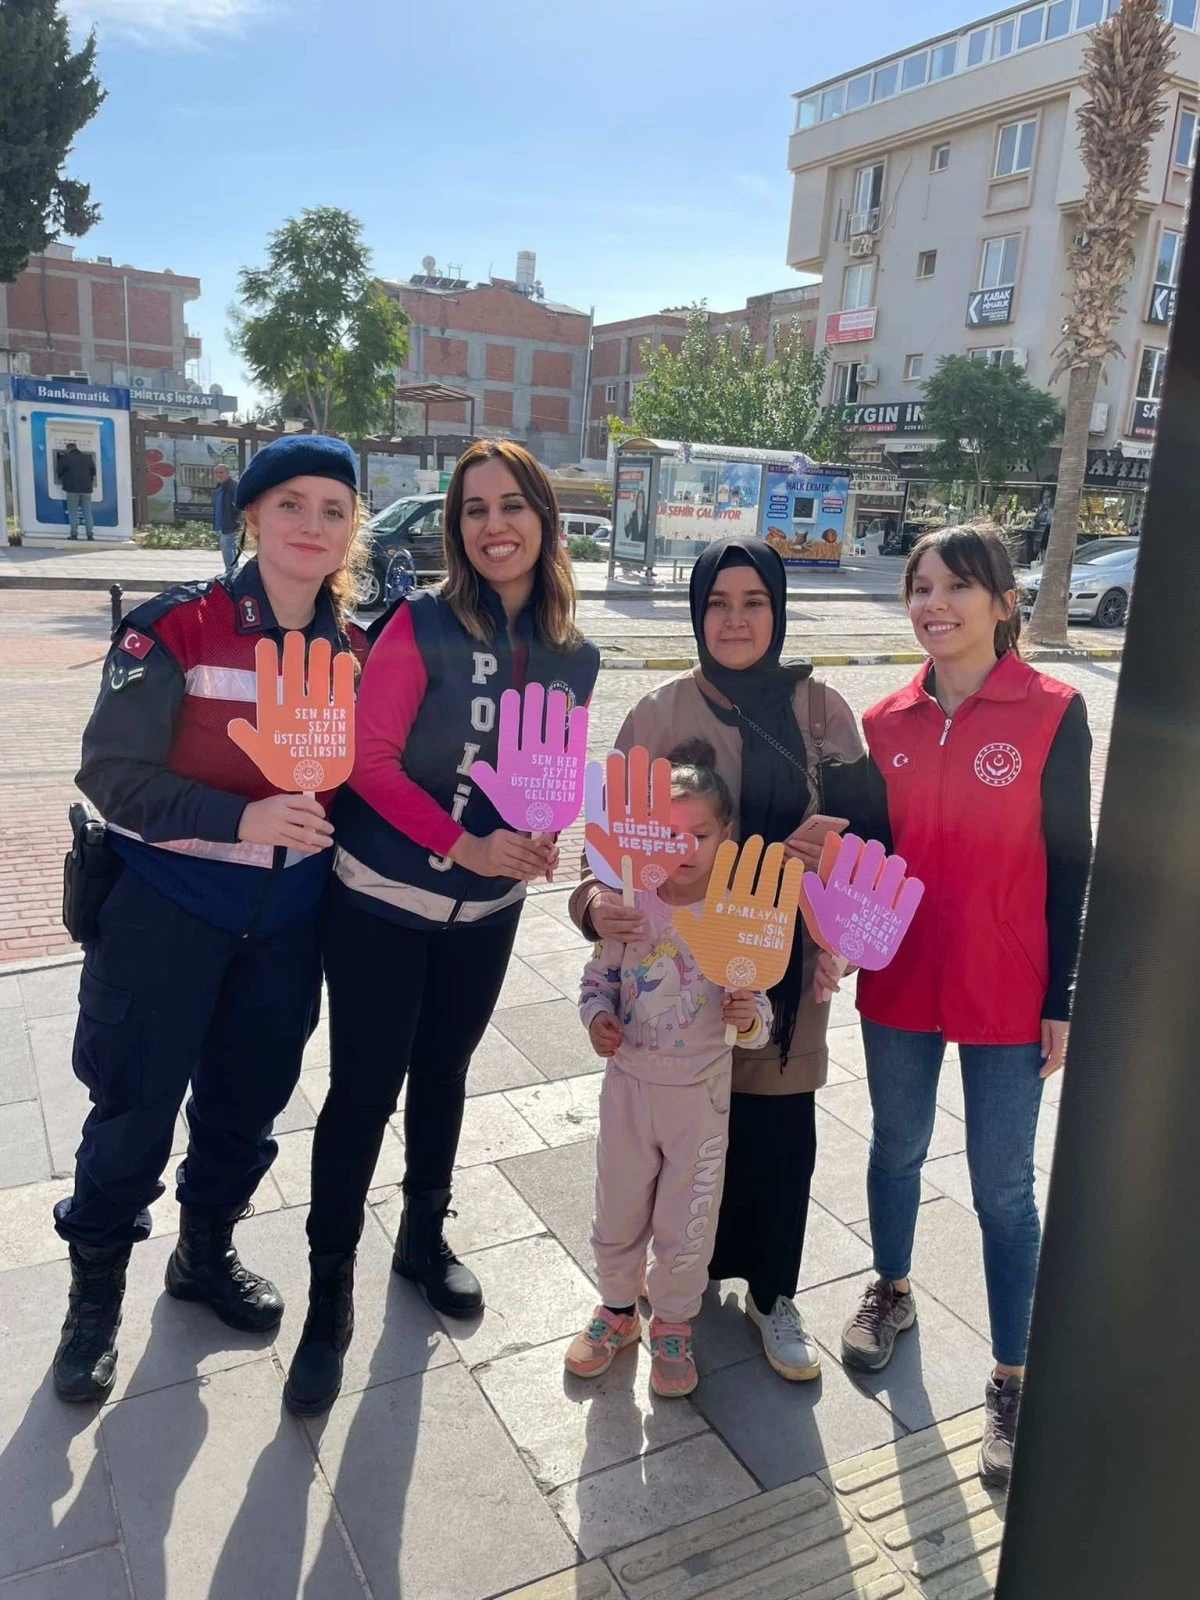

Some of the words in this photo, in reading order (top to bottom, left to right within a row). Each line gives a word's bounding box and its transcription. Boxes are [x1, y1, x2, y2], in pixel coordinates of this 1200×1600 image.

[984, 289, 1011, 302] KABAK
[38, 386, 110, 402] Bankamatik
[130, 389, 174, 403] EMİRTAŞ
[175, 391, 213, 406] İNŞAAT
[786, 481, 805, 492] HALK
[806, 482, 830, 493] EKMEK
[667, 504, 694, 518] ŞEHİR
[295, 708, 317, 720] SEN
[323, 708, 346, 720] HER
[274, 730, 346, 745] ÜSTESİNDEN
[532, 754, 552, 765] SEN
[557, 756, 578, 767] HER
[511, 773, 576, 790] ÜSTESİNDEN
[613, 818, 684, 840] GÜCÜN
[618, 836, 688, 856] KEŞFET
[727, 904, 788, 924] PARLAYAN
[882, 921, 898, 936] EN
[737, 932, 784, 951] SENSİN
